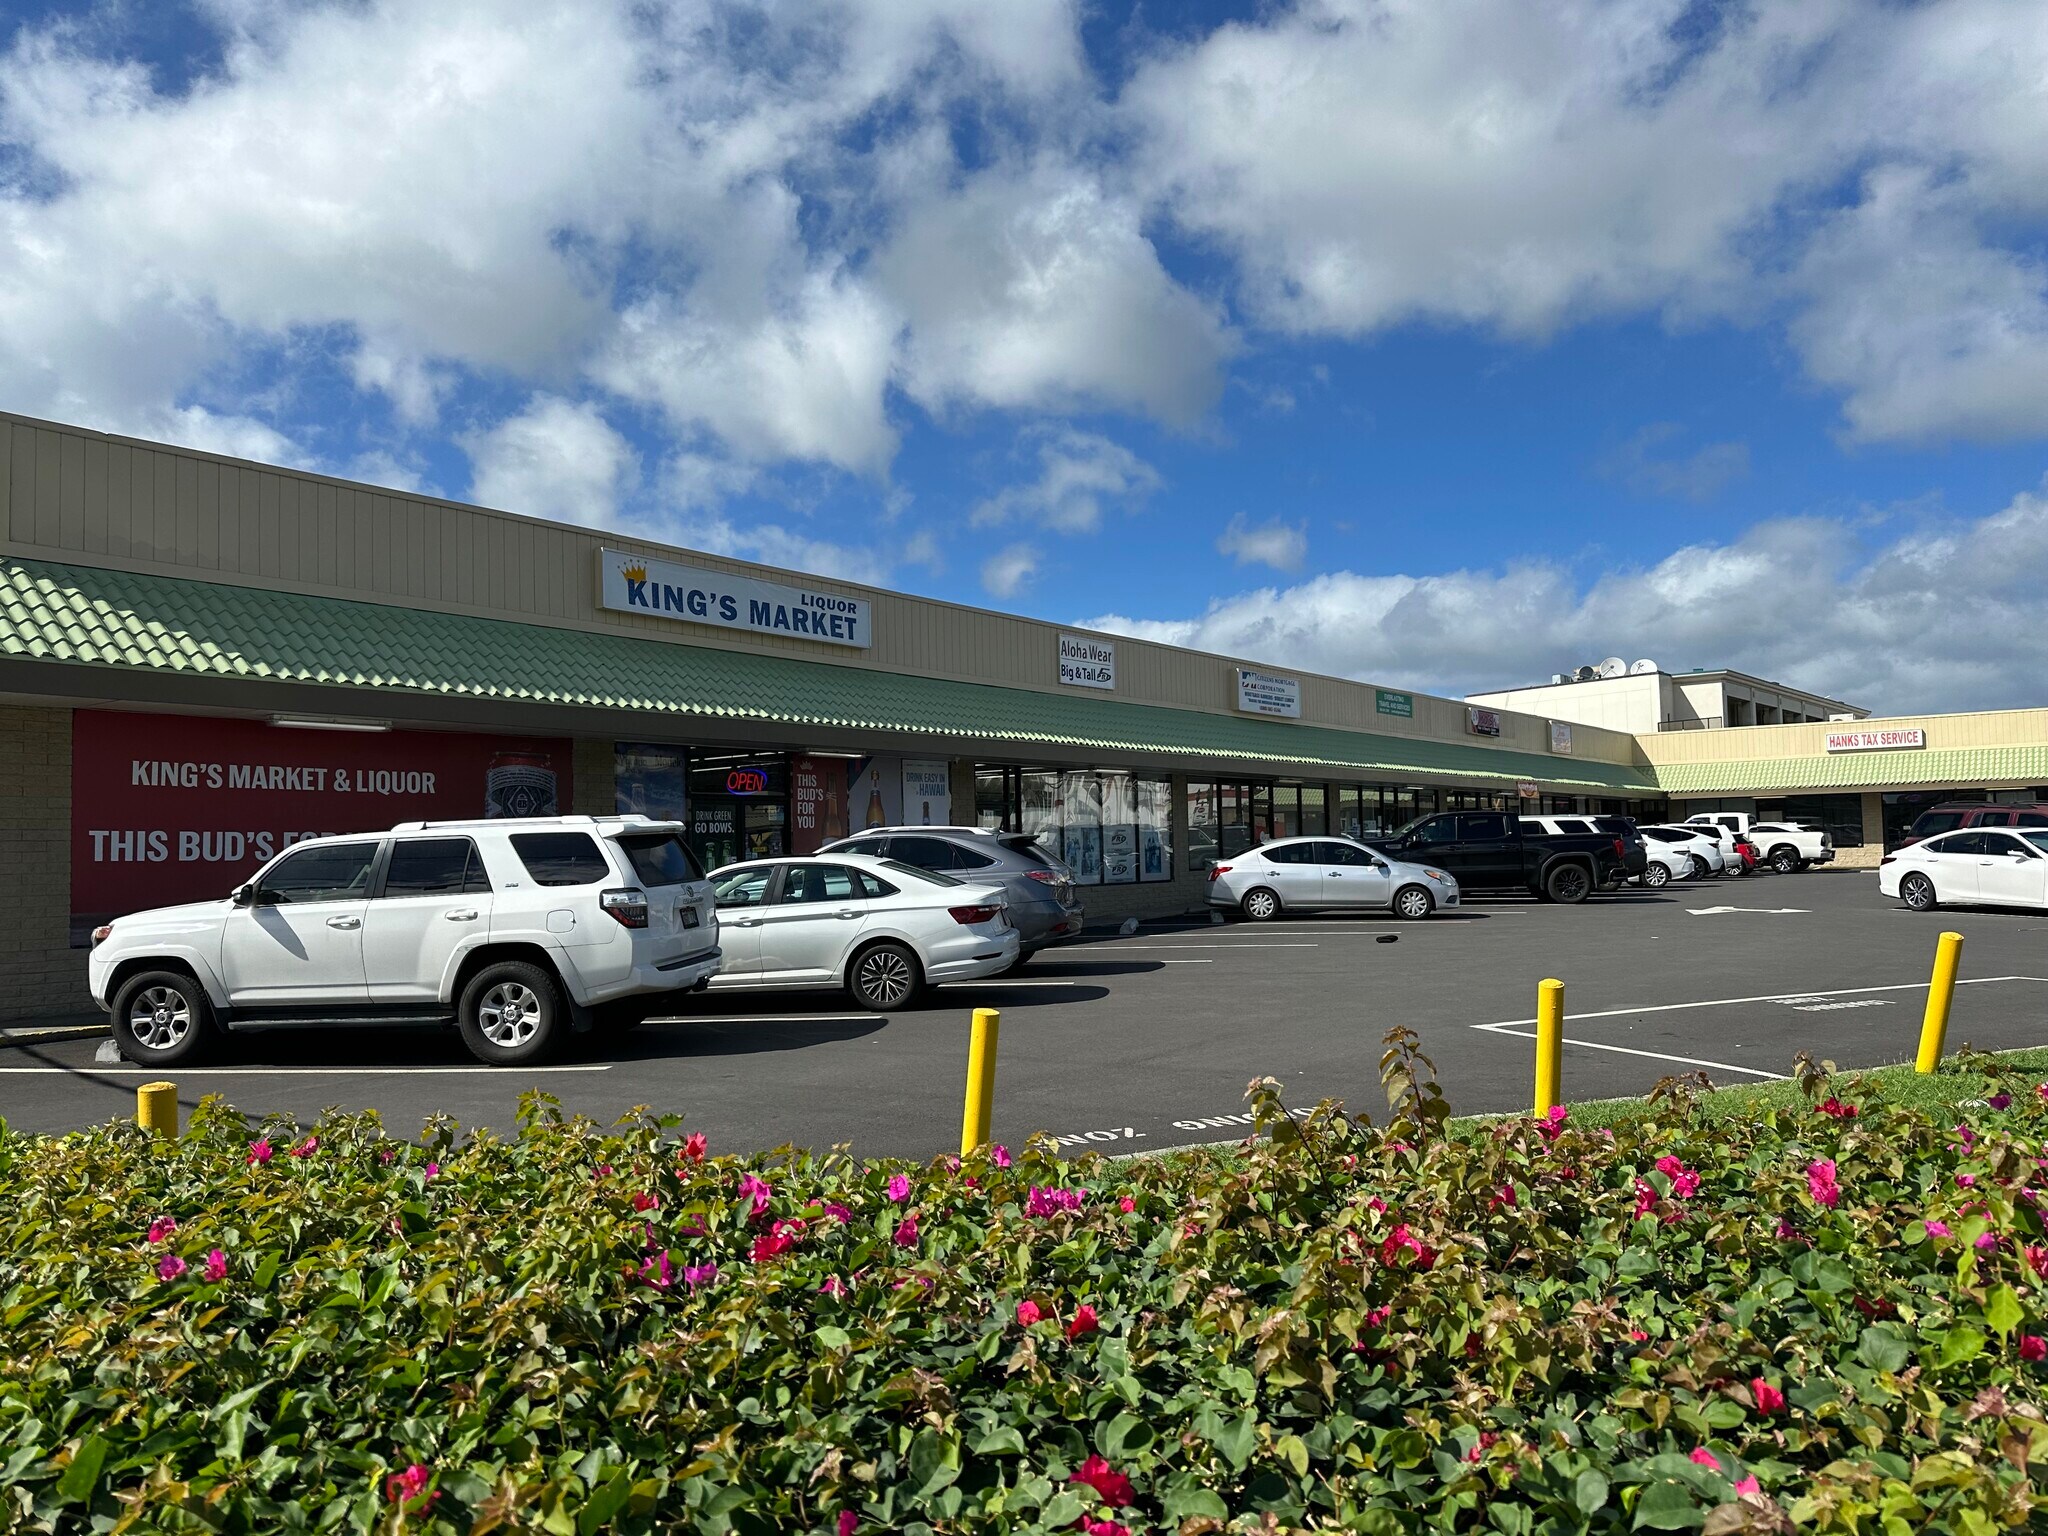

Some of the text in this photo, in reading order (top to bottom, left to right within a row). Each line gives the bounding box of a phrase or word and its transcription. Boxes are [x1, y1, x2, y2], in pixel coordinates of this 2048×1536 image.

[627, 578, 857, 640] KING'S MARKET
[801, 593, 857, 614] LIQUOR
[1061, 640, 1112, 663] Aloha Wear
[1061, 664, 1096, 681] Big & Tall
[1829, 731, 1919, 748] HANKS TAX SERVICE
[131, 760, 436, 795] KING'S MARKET & LIQUOR
[727, 771, 764, 791] OPEN
[797, 774, 817, 787] THIS
[906, 772, 945, 783] DRINK EASY IN
[797, 788, 824, 801] BUD'S
[920, 783, 946, 796] HAWAII
[695, 810, 713, 820] DRINK
[797, 802, 815, 815] FOR
[695, 822, 735, 834] GO BOWS.
[797, 816, 815, 829] YOU
[89, 830, 169, 862] THIS
[178, 831, 274, 862] BUD'S
[1033, 1127, 1146, 1149] ZON
